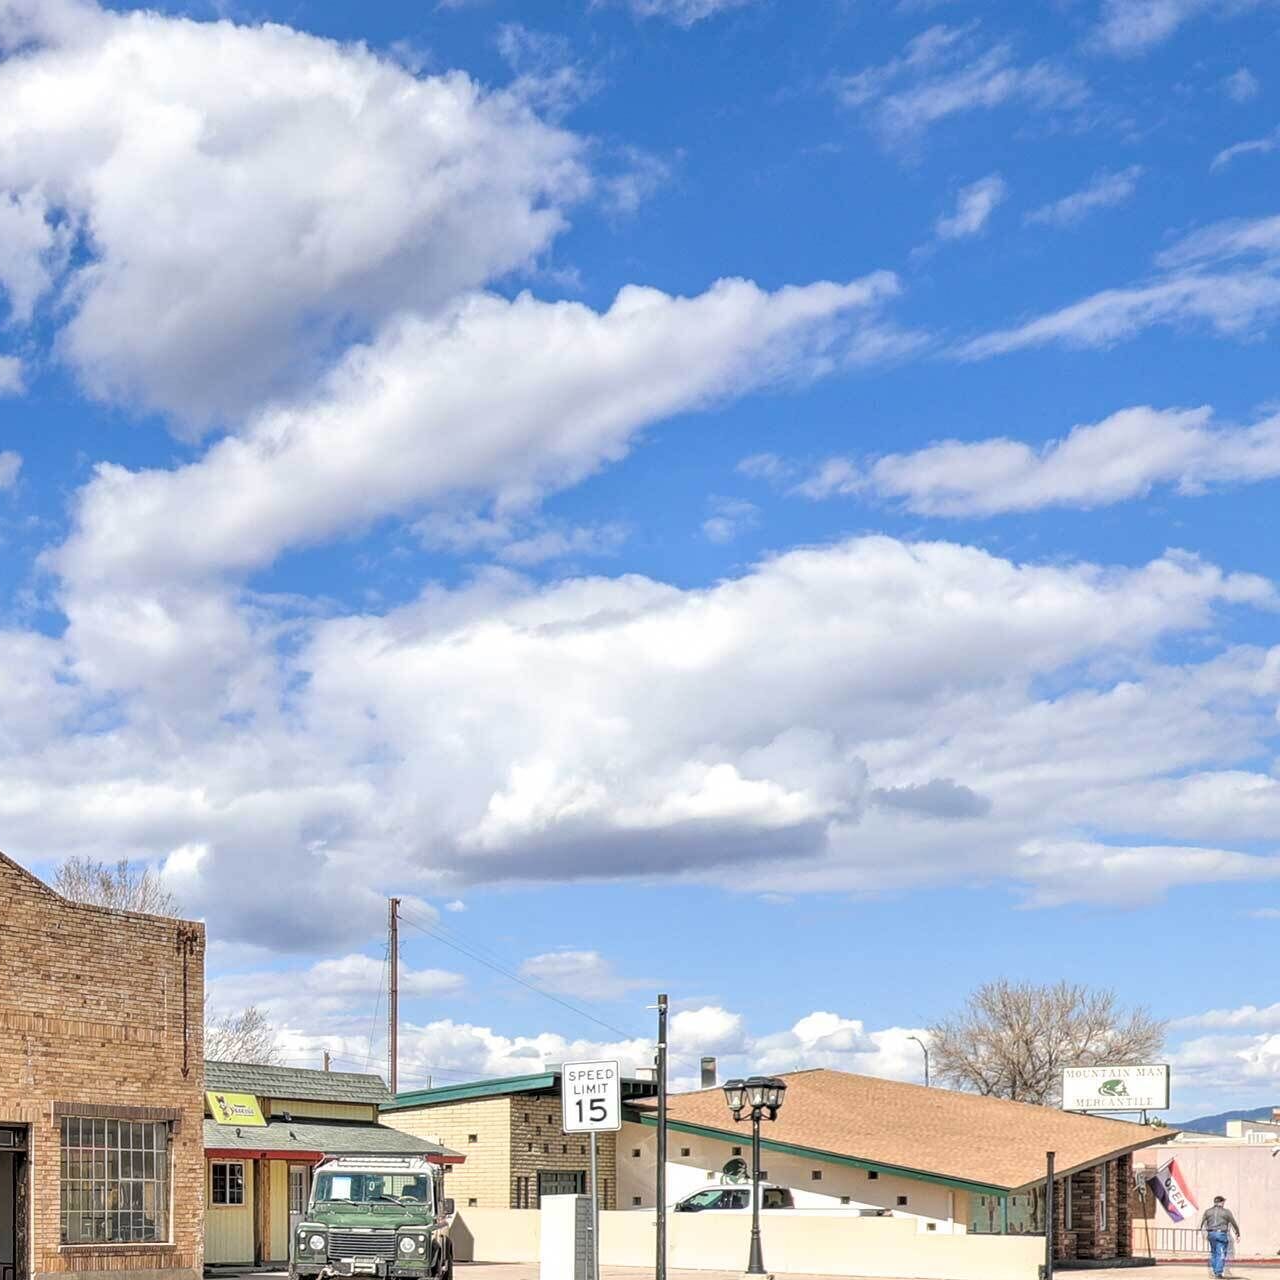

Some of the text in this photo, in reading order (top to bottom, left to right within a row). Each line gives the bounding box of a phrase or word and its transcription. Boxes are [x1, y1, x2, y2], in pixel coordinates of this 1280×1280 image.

[568, 1069, 614, 1081] SPEED
[1065, 1068, 1164, 1079] MOUNTAIN MAN
[573, 1082, 608, 1095] LIMIT
[1076, 1097, 1153, 1108] MERCANTILE
[575, 1098, 607, 1123] 15
[1164, 1177, 1188, 1210] OPEN
